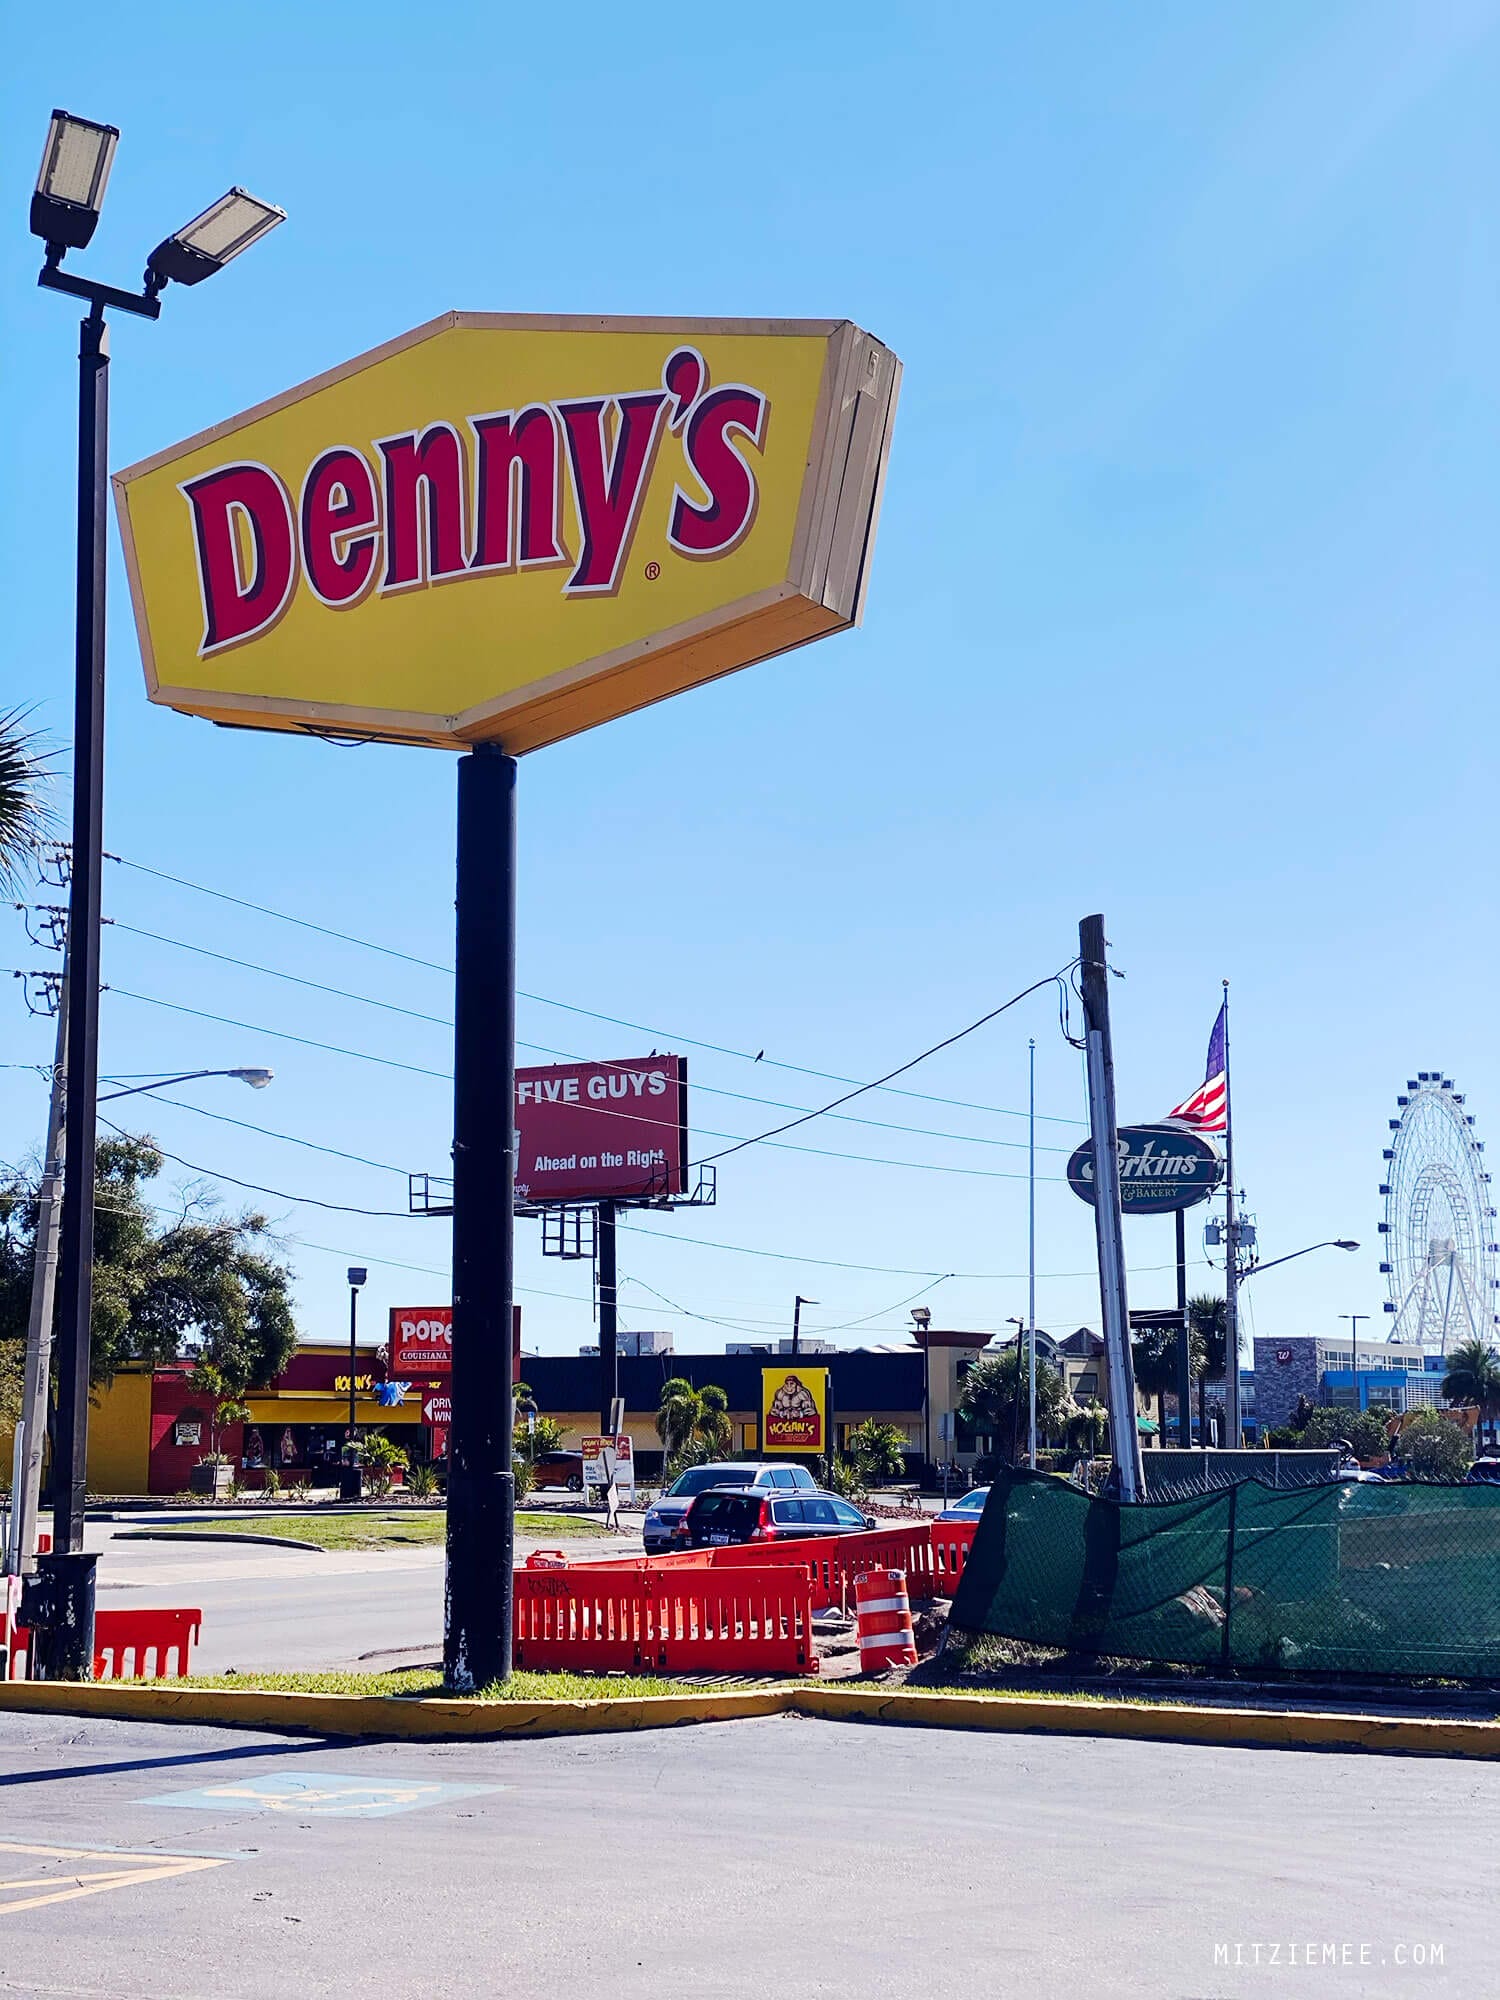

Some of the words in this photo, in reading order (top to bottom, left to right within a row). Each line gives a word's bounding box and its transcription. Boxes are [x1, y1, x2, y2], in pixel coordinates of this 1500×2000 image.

[177, 345, 766, 658] Denny's
[518, 1078, 580, 1105] FIVE
[587, 1070, 667, 1100] GUYS
[534, 1155, 576, 1172] Ahead
[580, 1157, 597, 1169] on
[601, 1152, 623, 1168] the
[627, 1149, 665, 1170] Right
[402, 1351, 448, 1360] LOUISIANA
[769, 1421, 816, 1436] HOGAN'S
